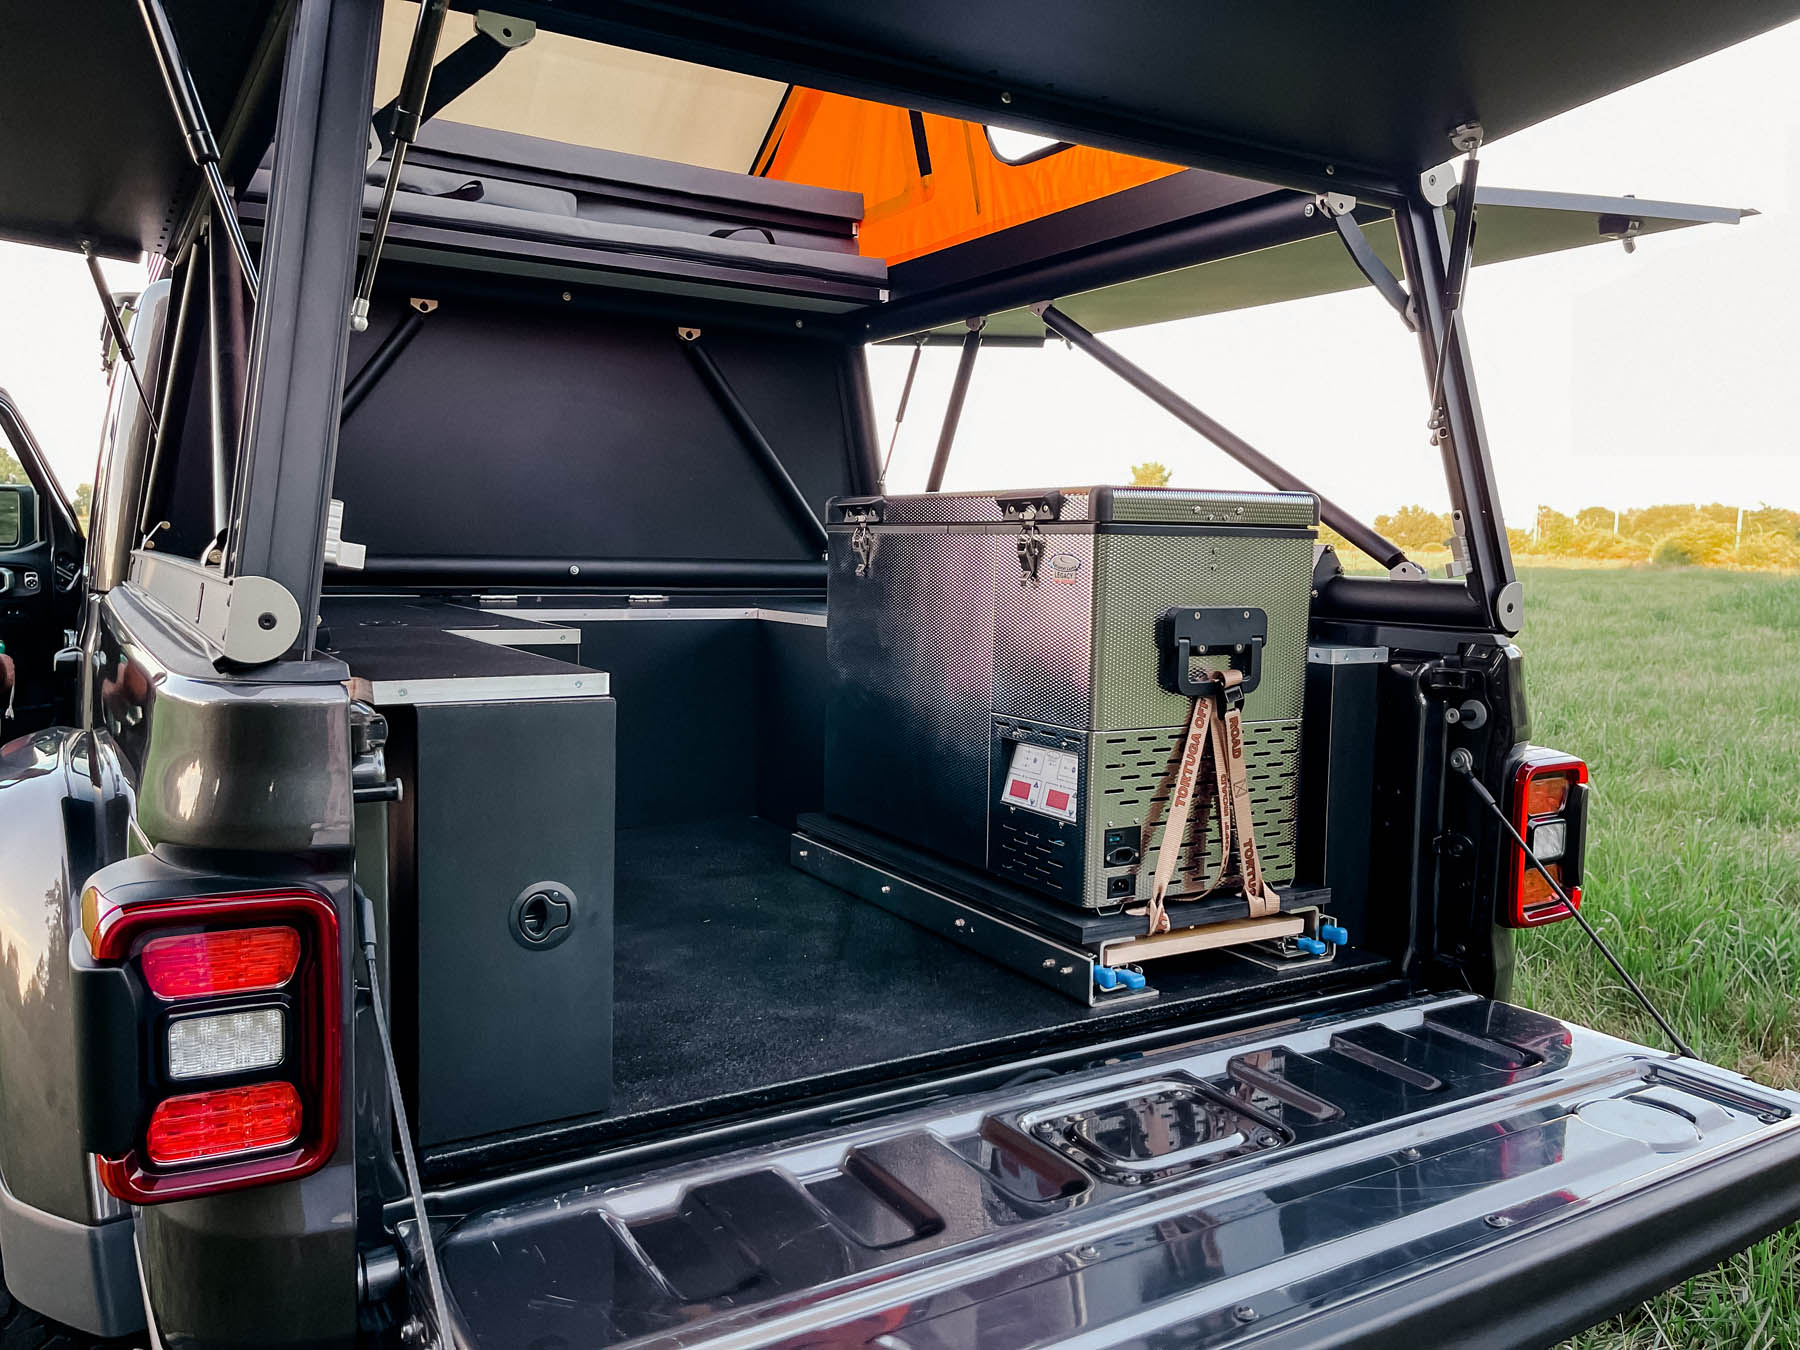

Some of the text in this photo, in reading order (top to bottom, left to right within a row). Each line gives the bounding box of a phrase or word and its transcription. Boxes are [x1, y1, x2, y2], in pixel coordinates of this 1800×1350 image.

[1054, 571, 1074, 579] LEGACY
[1175, 698, 1209, 808] TORTUGA OFF
[1229, 715, 1242, 759] ROAD
